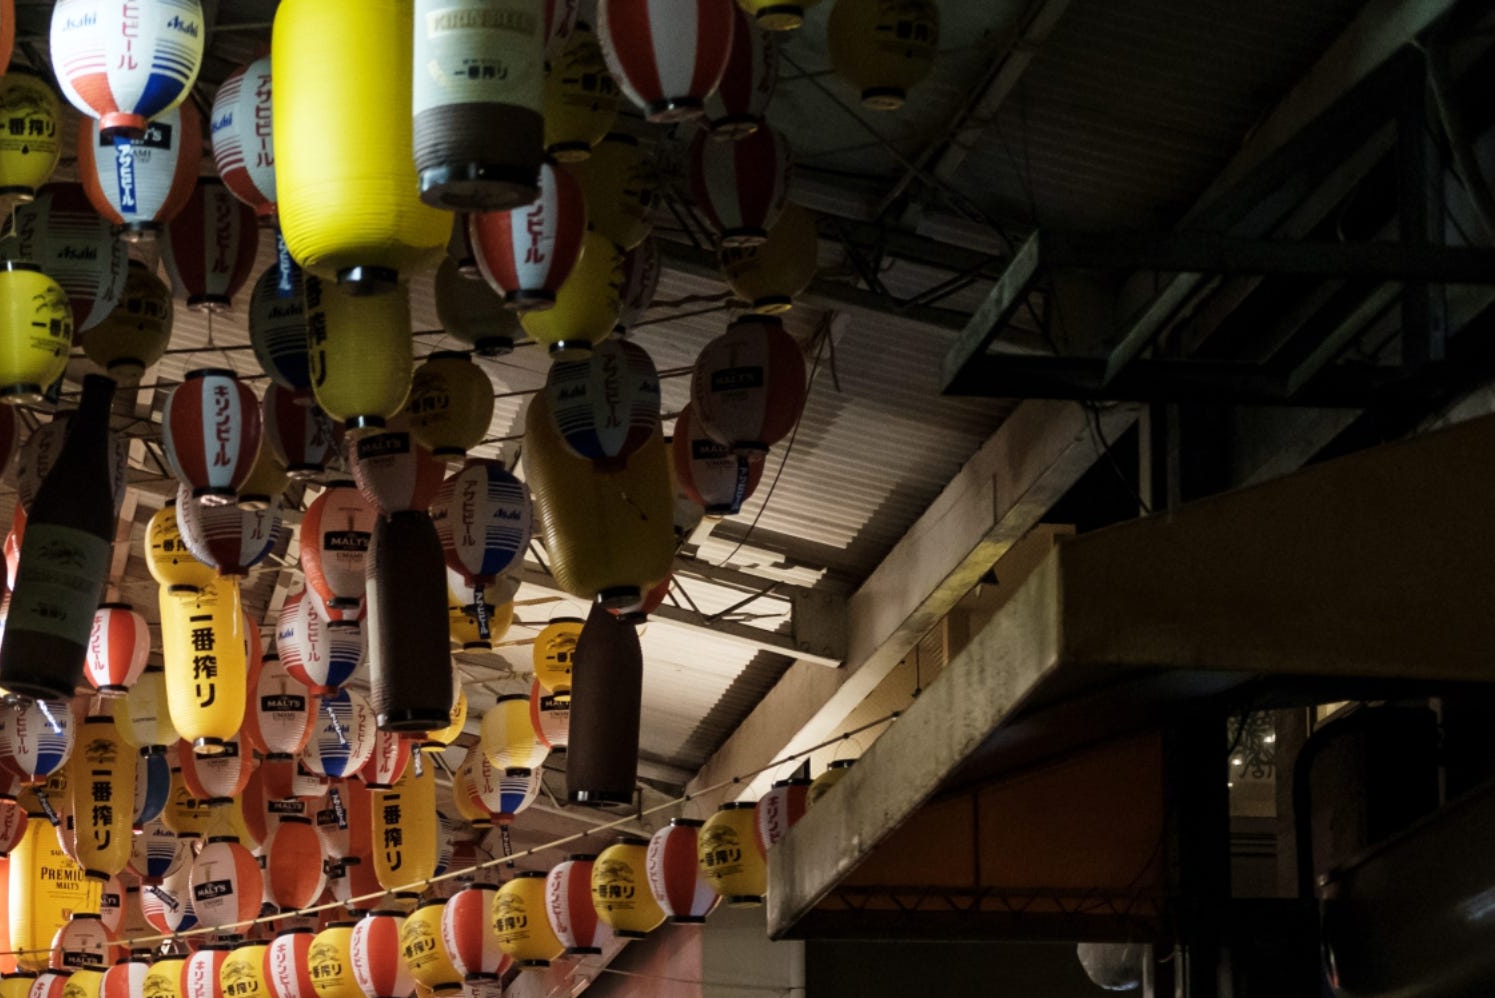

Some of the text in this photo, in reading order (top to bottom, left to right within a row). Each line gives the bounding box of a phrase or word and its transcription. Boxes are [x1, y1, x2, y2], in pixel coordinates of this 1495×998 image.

[167, 15, 198, 38] Asahi
[57, 246, 97, 260] Asahi
[33, 319, 71, 338] 一番搾
[213, 386, 231, 467] キリンビール
[462, 480, 477, 547] アサヒビール
[153, 539, 187, 552] 一番搾
[190, 615, 218, 708] 一番搾り
[380, 734, 393, 773] リンビール
[91, 769, 113, 851] 一番搾り
[384, 793, 402, 871] 一番搾り
[41, 867, 84, 881] PREMIU
[198, 884, 226, 896] MALT'S
[592, 884, 635, 899] 一番搾り
[309, 963, 342, 979] 一番搾り
[223, 981, 259, 997] 一番搾り
